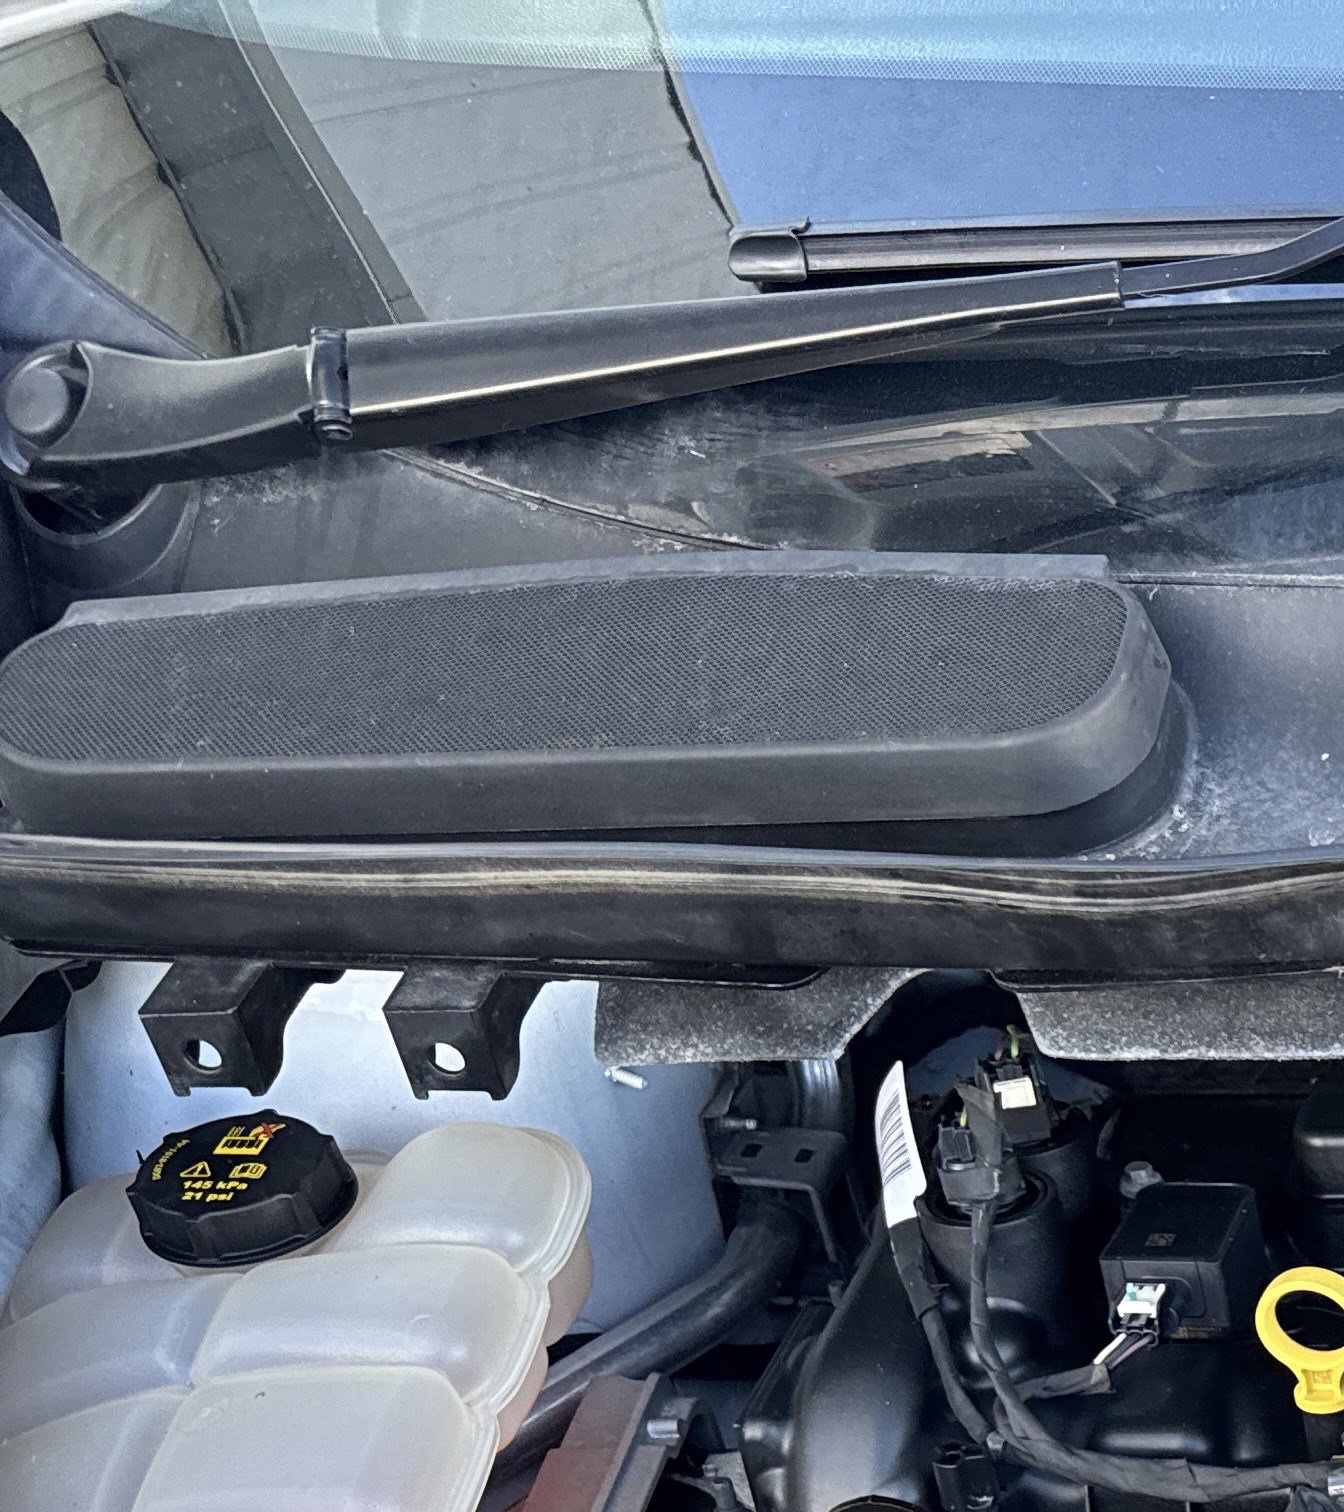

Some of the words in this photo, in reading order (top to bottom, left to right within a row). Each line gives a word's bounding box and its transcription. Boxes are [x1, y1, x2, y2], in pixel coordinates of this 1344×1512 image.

[184, 1181, 213, 1189] 145
[216, 1181, 248, 1189] kPa
[181, 1192, 204, 1200] 21
[206, 1192, 234, 1202] psi
